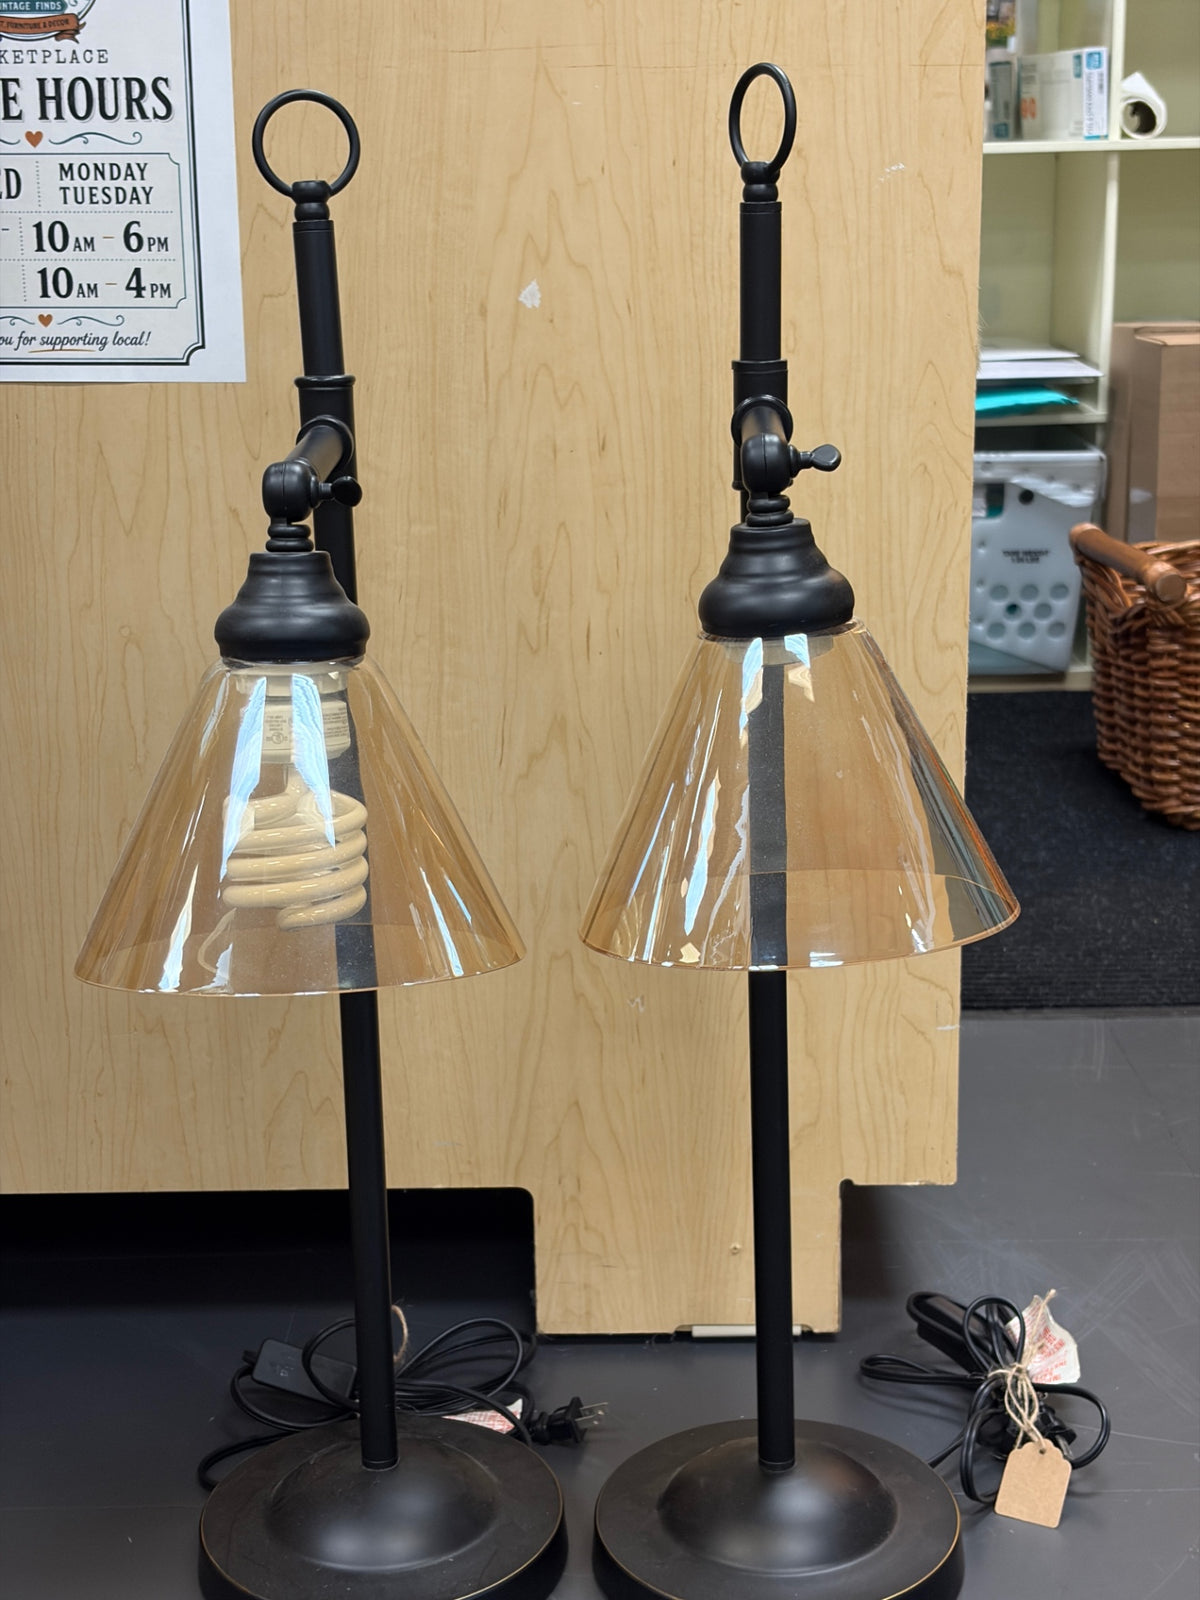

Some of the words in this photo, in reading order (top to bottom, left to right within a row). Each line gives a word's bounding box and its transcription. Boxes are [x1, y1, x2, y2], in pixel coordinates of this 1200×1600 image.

[36, 1, 62, 11] FINDS
[0, 78, 23, 121] E
[36, 76, 173, 122] HOURS
[58, 162, 149, 181] MONDAY
[59, 186, 154, 205] TUESDAY
[14, 330, 37, 351] for
[39, 332, 110, 352] supporting
[112, 330, 152, 346] local!
